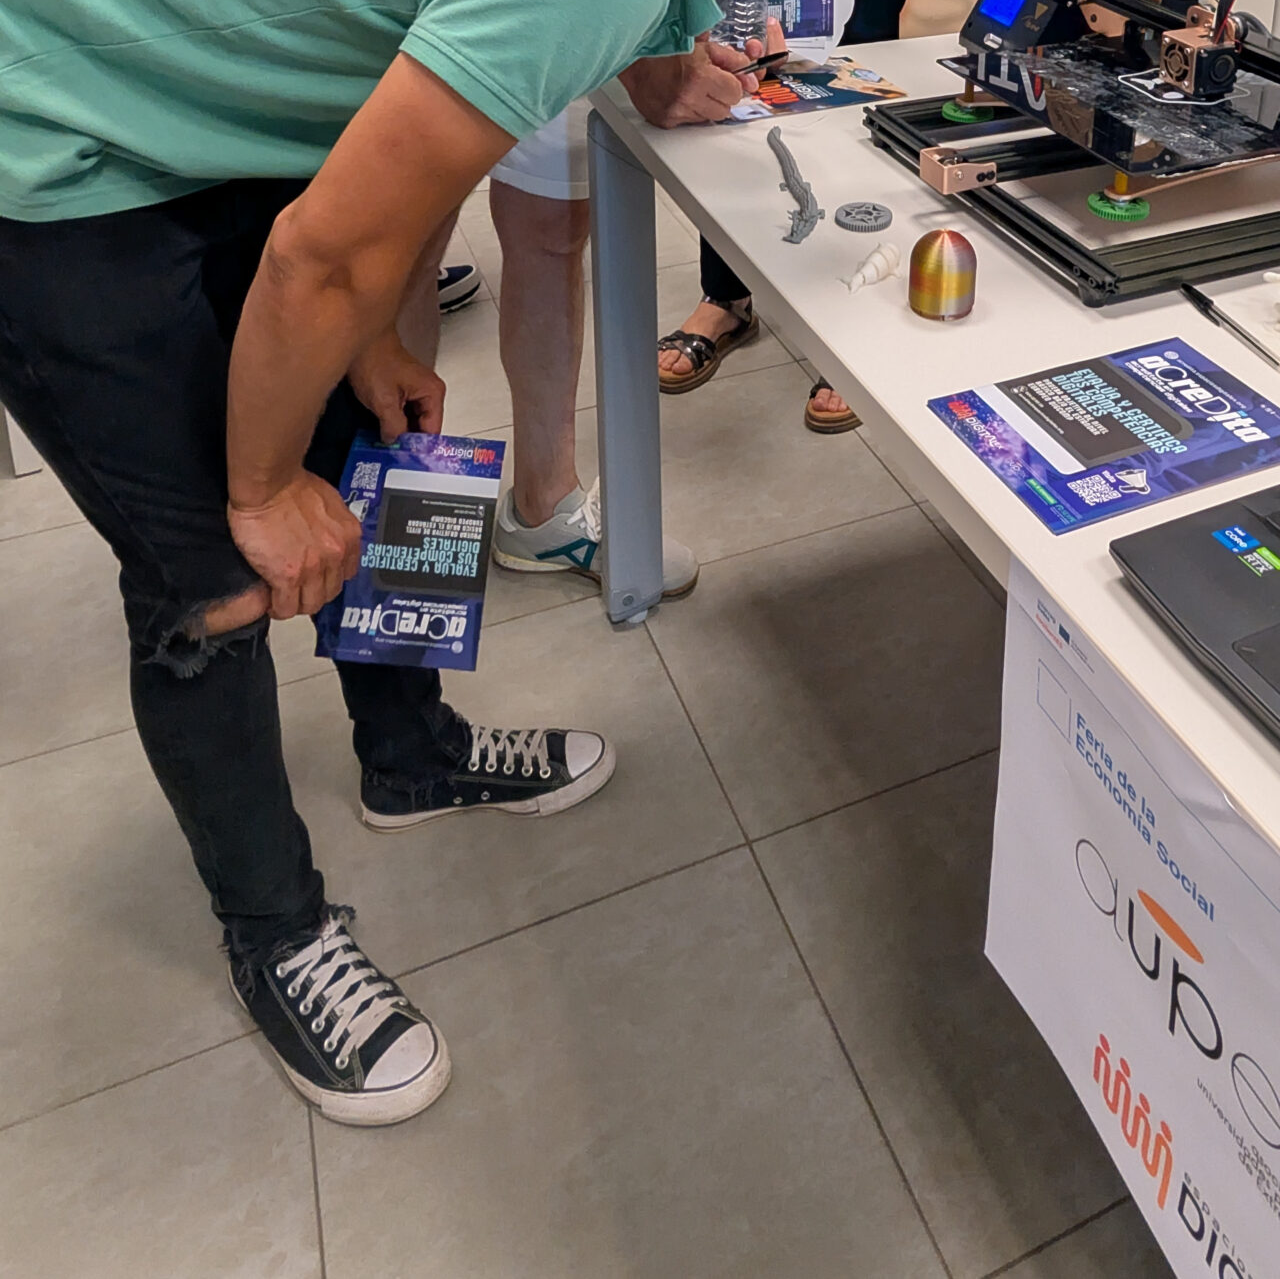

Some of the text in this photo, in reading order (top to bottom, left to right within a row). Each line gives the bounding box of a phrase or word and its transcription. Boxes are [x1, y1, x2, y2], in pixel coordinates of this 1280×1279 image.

[1051, 375, 1107, 417] DIGITALES
[1078, 368, 1188, 455] EVALÚA Y CERTIFICA
[1164, 390, 1193, 413] digitales
[1066, 371, 1091, 389] TUS
[1086, 387, 1171, 455] COMPETENCIAS
[367, 543, 479, 564] TUS COMPETENCIAS
[421, 536, 480, 552] DIGITALES
[361, 554, 479, 578] EVALÚA Y CERTIFICA
[1243, 554, 1269, 574] RTX
[1075, 712, 1156, 827] Feria de la
[1075, 733, 1215, 921] Economía Social
[1197, 1077, 1272, 1190] universidades
[1238, 1151, 1254, 1176] de
